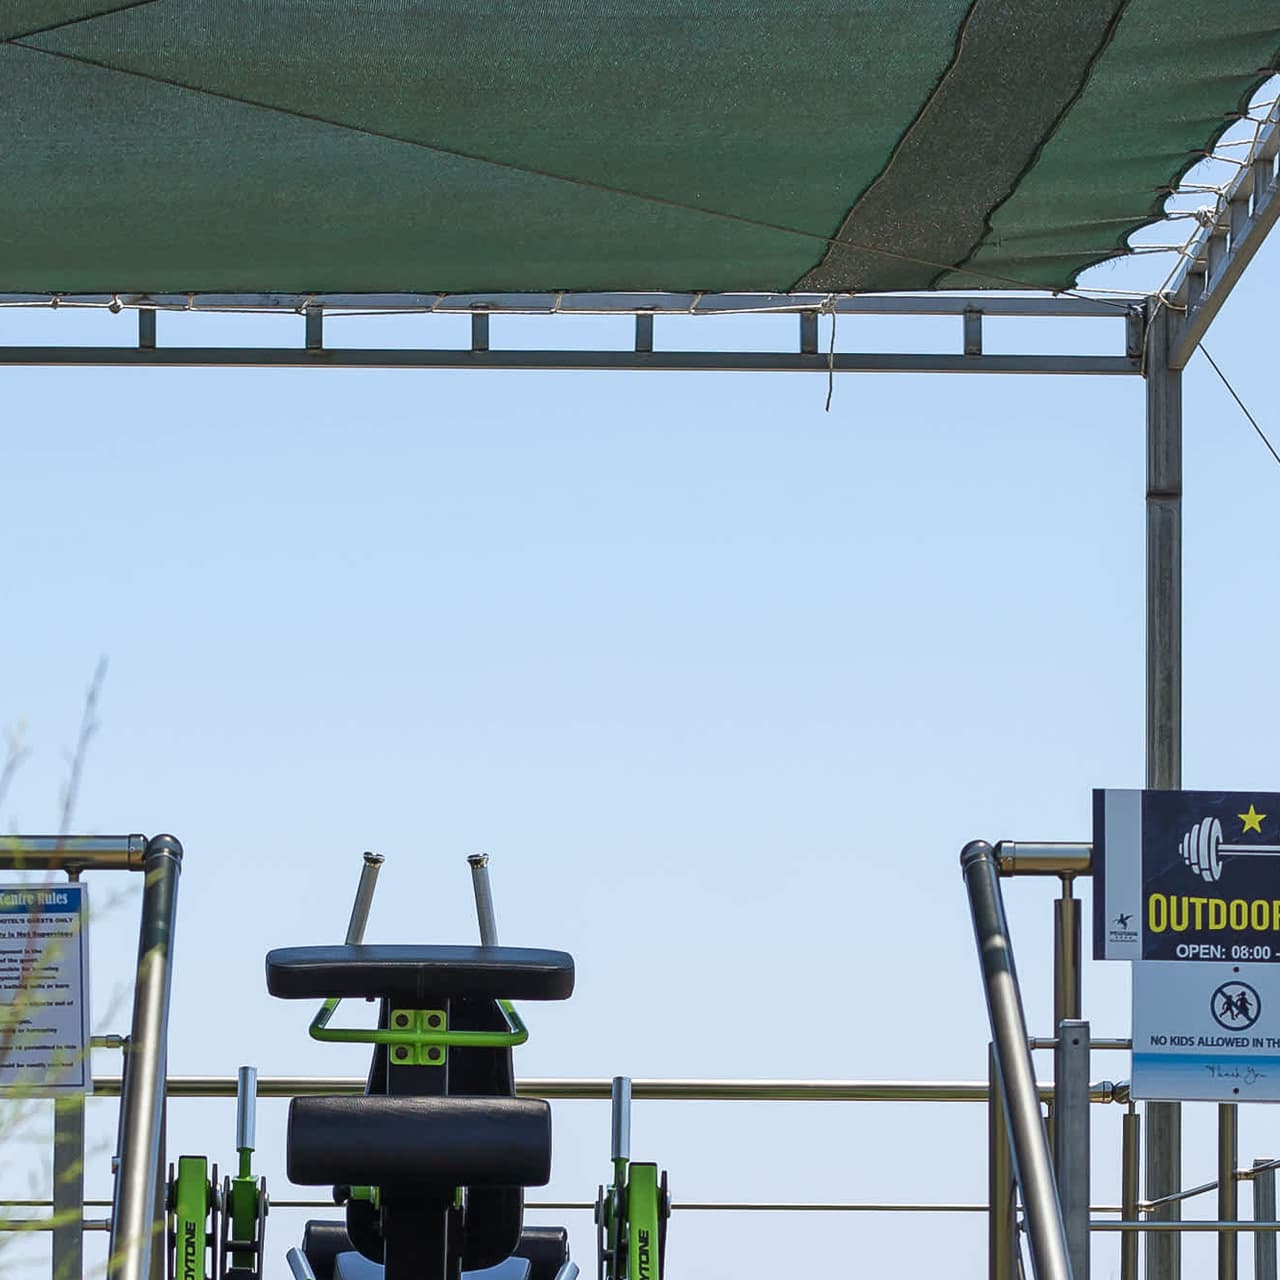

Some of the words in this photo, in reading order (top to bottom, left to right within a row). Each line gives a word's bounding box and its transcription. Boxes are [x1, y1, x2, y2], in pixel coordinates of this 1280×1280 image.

[37, 891, 68, 904] Rules
[1176, 944, 1227, 960] OPEN:
[1231, 945, 1271, 960] 08:00
[1150, 1036, 1167, 1046] NO
[1170, 1036, 1195, 1047] KIDS
[1196, 1037, 1250, 1048] ALLOWED
[1252, 1038, 1263, 1048] IN
